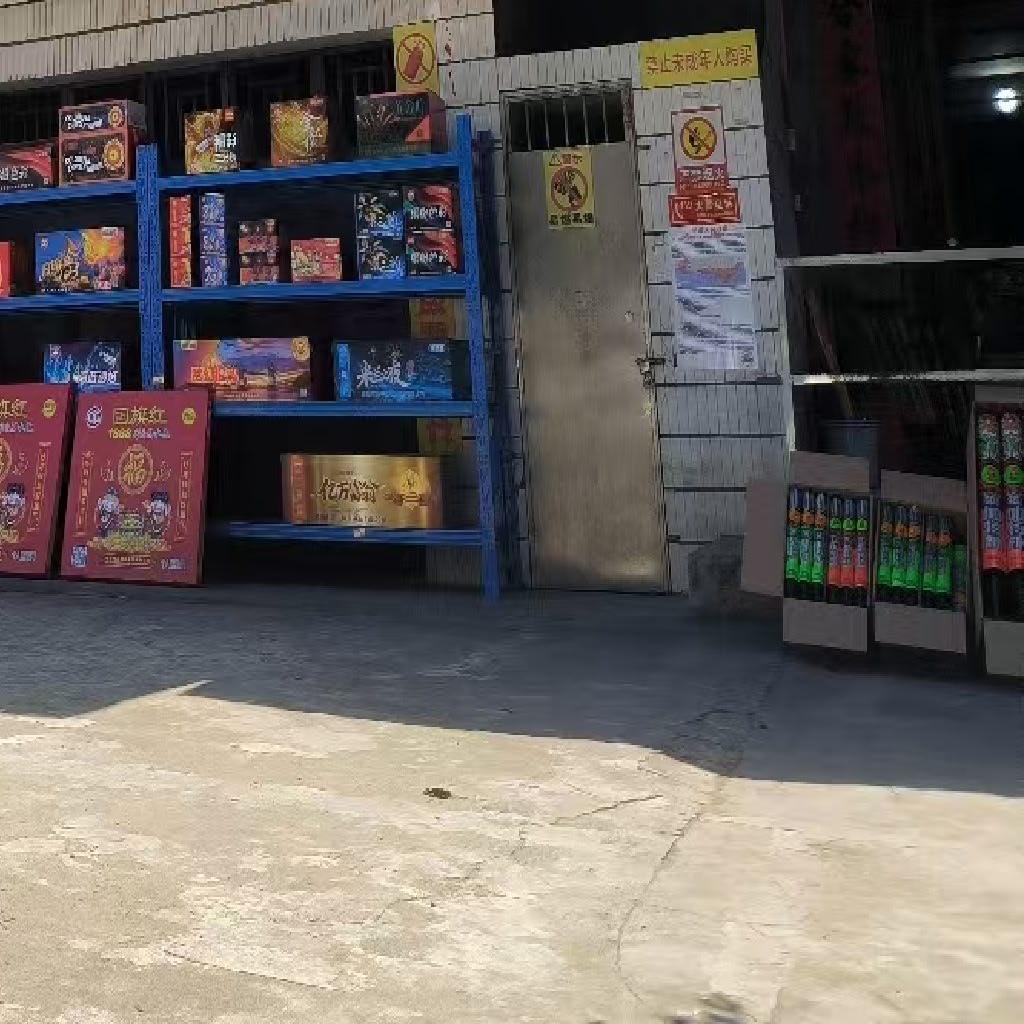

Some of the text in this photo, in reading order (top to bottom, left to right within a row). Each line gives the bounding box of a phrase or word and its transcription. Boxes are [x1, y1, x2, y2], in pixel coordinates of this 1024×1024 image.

[645, 44, 753, 74] 禁止未成年人购买
